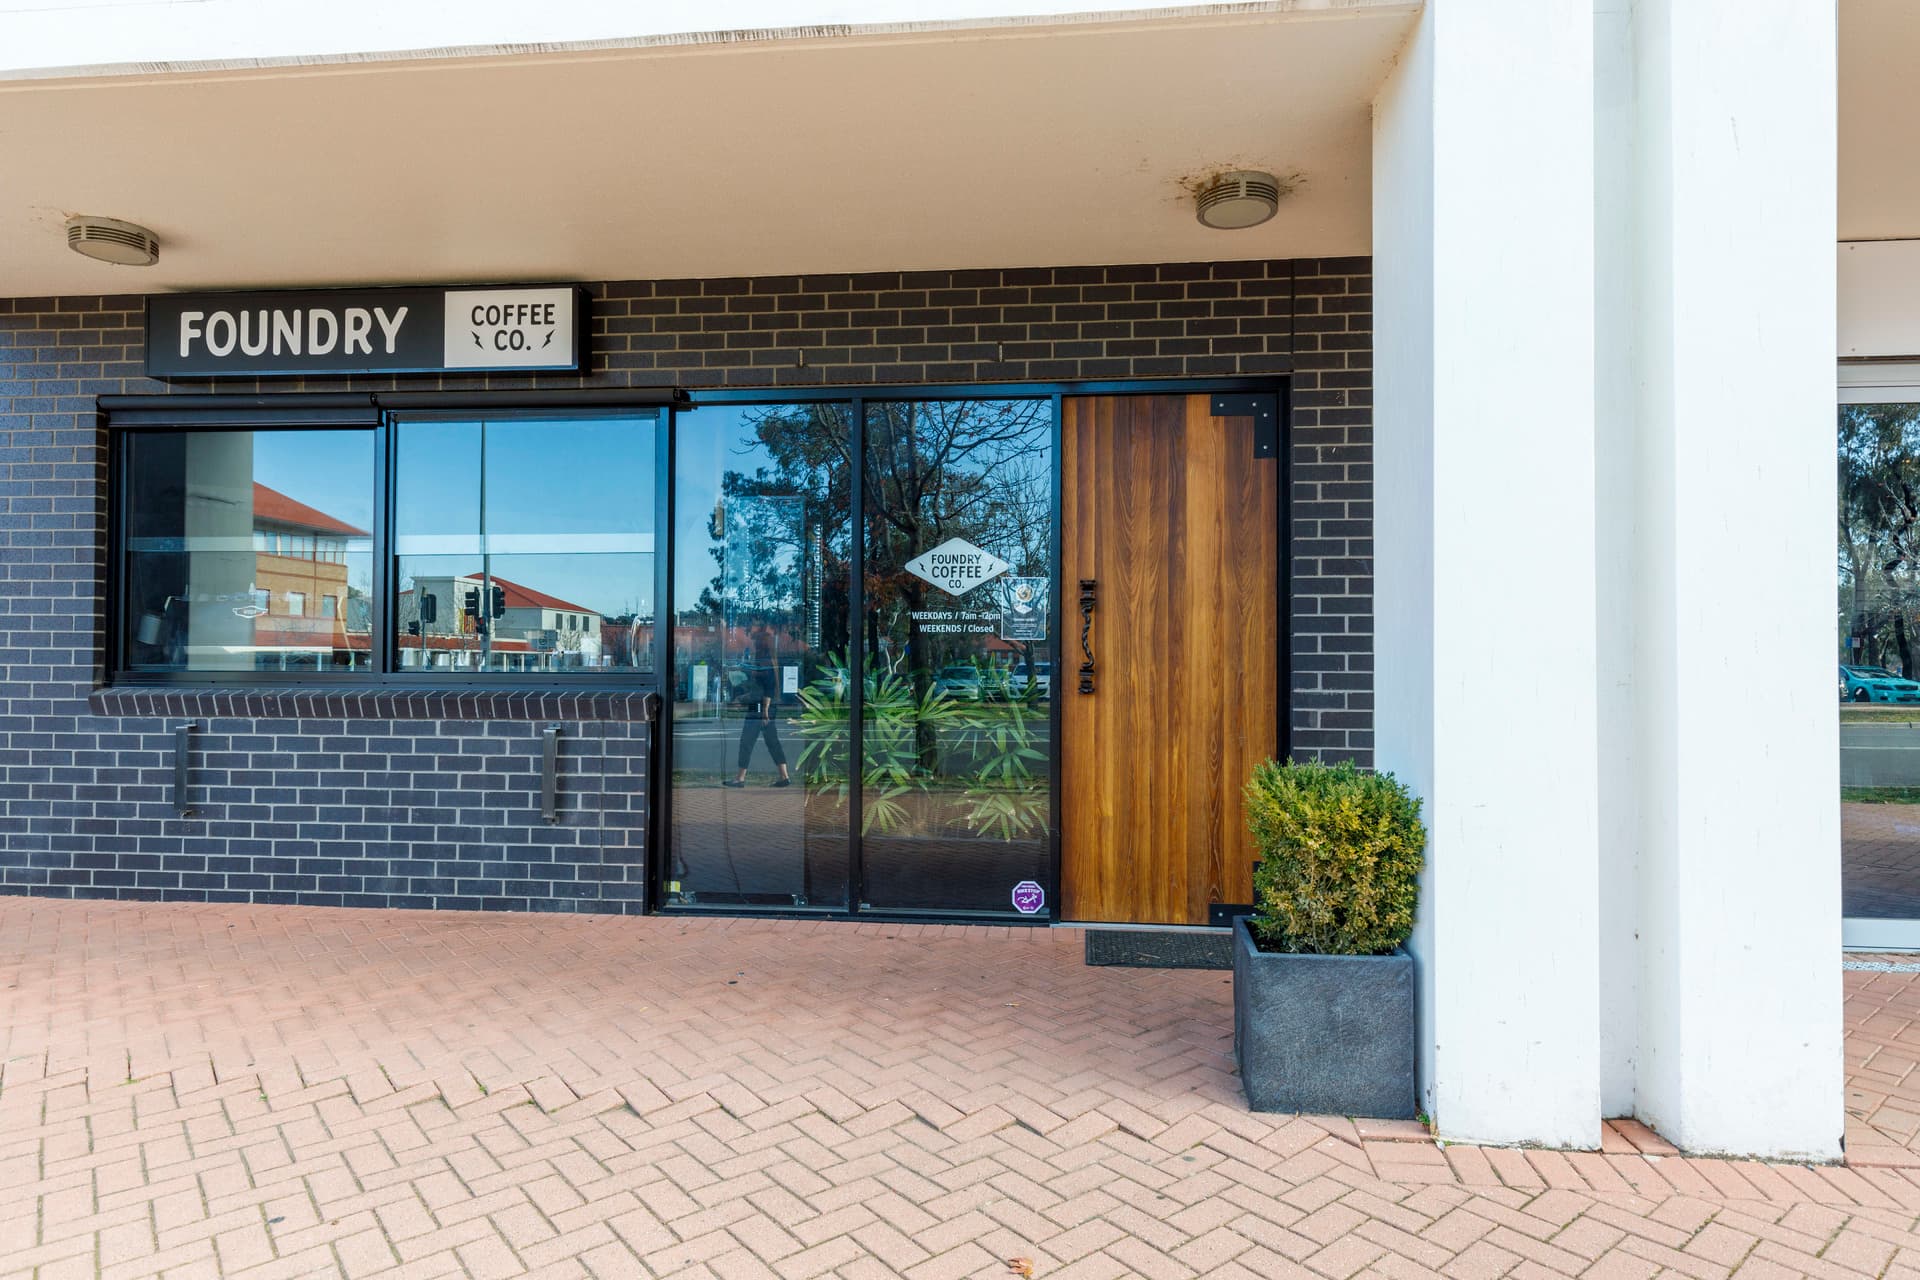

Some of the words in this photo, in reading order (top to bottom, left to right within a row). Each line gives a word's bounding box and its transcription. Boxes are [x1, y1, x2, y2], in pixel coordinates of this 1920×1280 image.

[470, 303, 556, 327] COFFEE
[179, 306, 409, 358] FOUNDRY
[493, 329, 532, 352] CO.
[931, 554, 982, 565] FOUNDRY
[931, 566, 982, 578] COFFEE
[948, 580, 965, 589] CO.
[911, 611, 953, 620] WEEKDAYS
[961, 611, 977, 620] 7am
[919, 624, 962, 633] WEEKENDS
[967, 624, 994, 633] Closed
